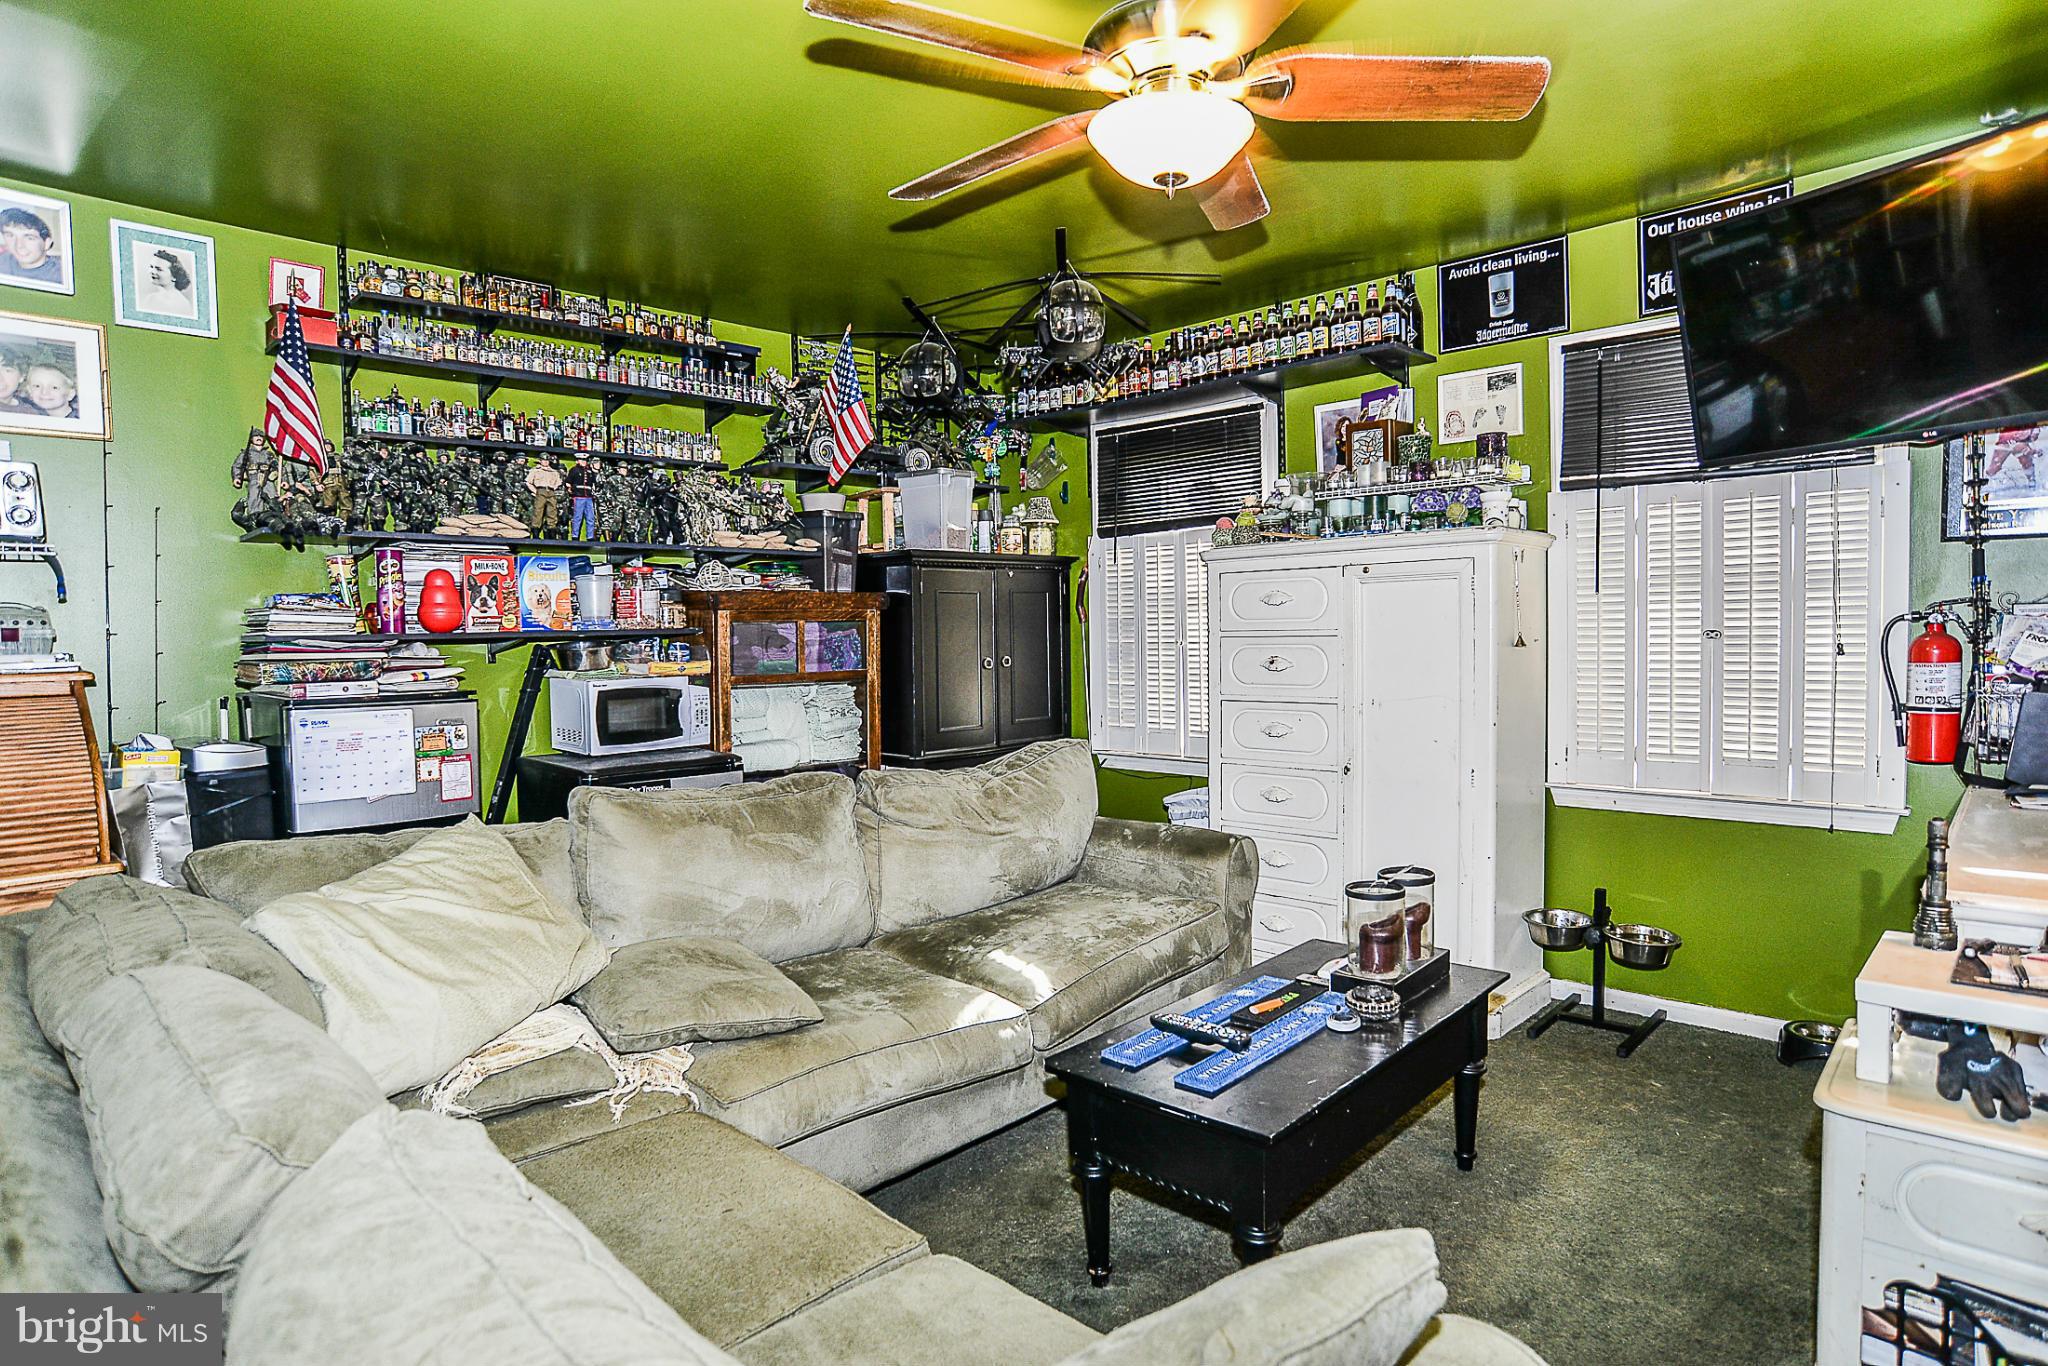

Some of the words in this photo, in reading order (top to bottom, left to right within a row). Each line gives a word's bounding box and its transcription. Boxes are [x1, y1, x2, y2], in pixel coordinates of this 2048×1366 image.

[1648, 222, 1674, 238] Our
[1677, 211, 1722, 231] house
[1725, 200, 1764, 218] wine
[1448, 262, 1480, 280] Avoid
[1482, 260, 1512, 272] clean
[1514, 250, 1560, 266] living...
[474, 562, 505, 572] MILK-BONE
[379, 572, 402, 588] Prigles
